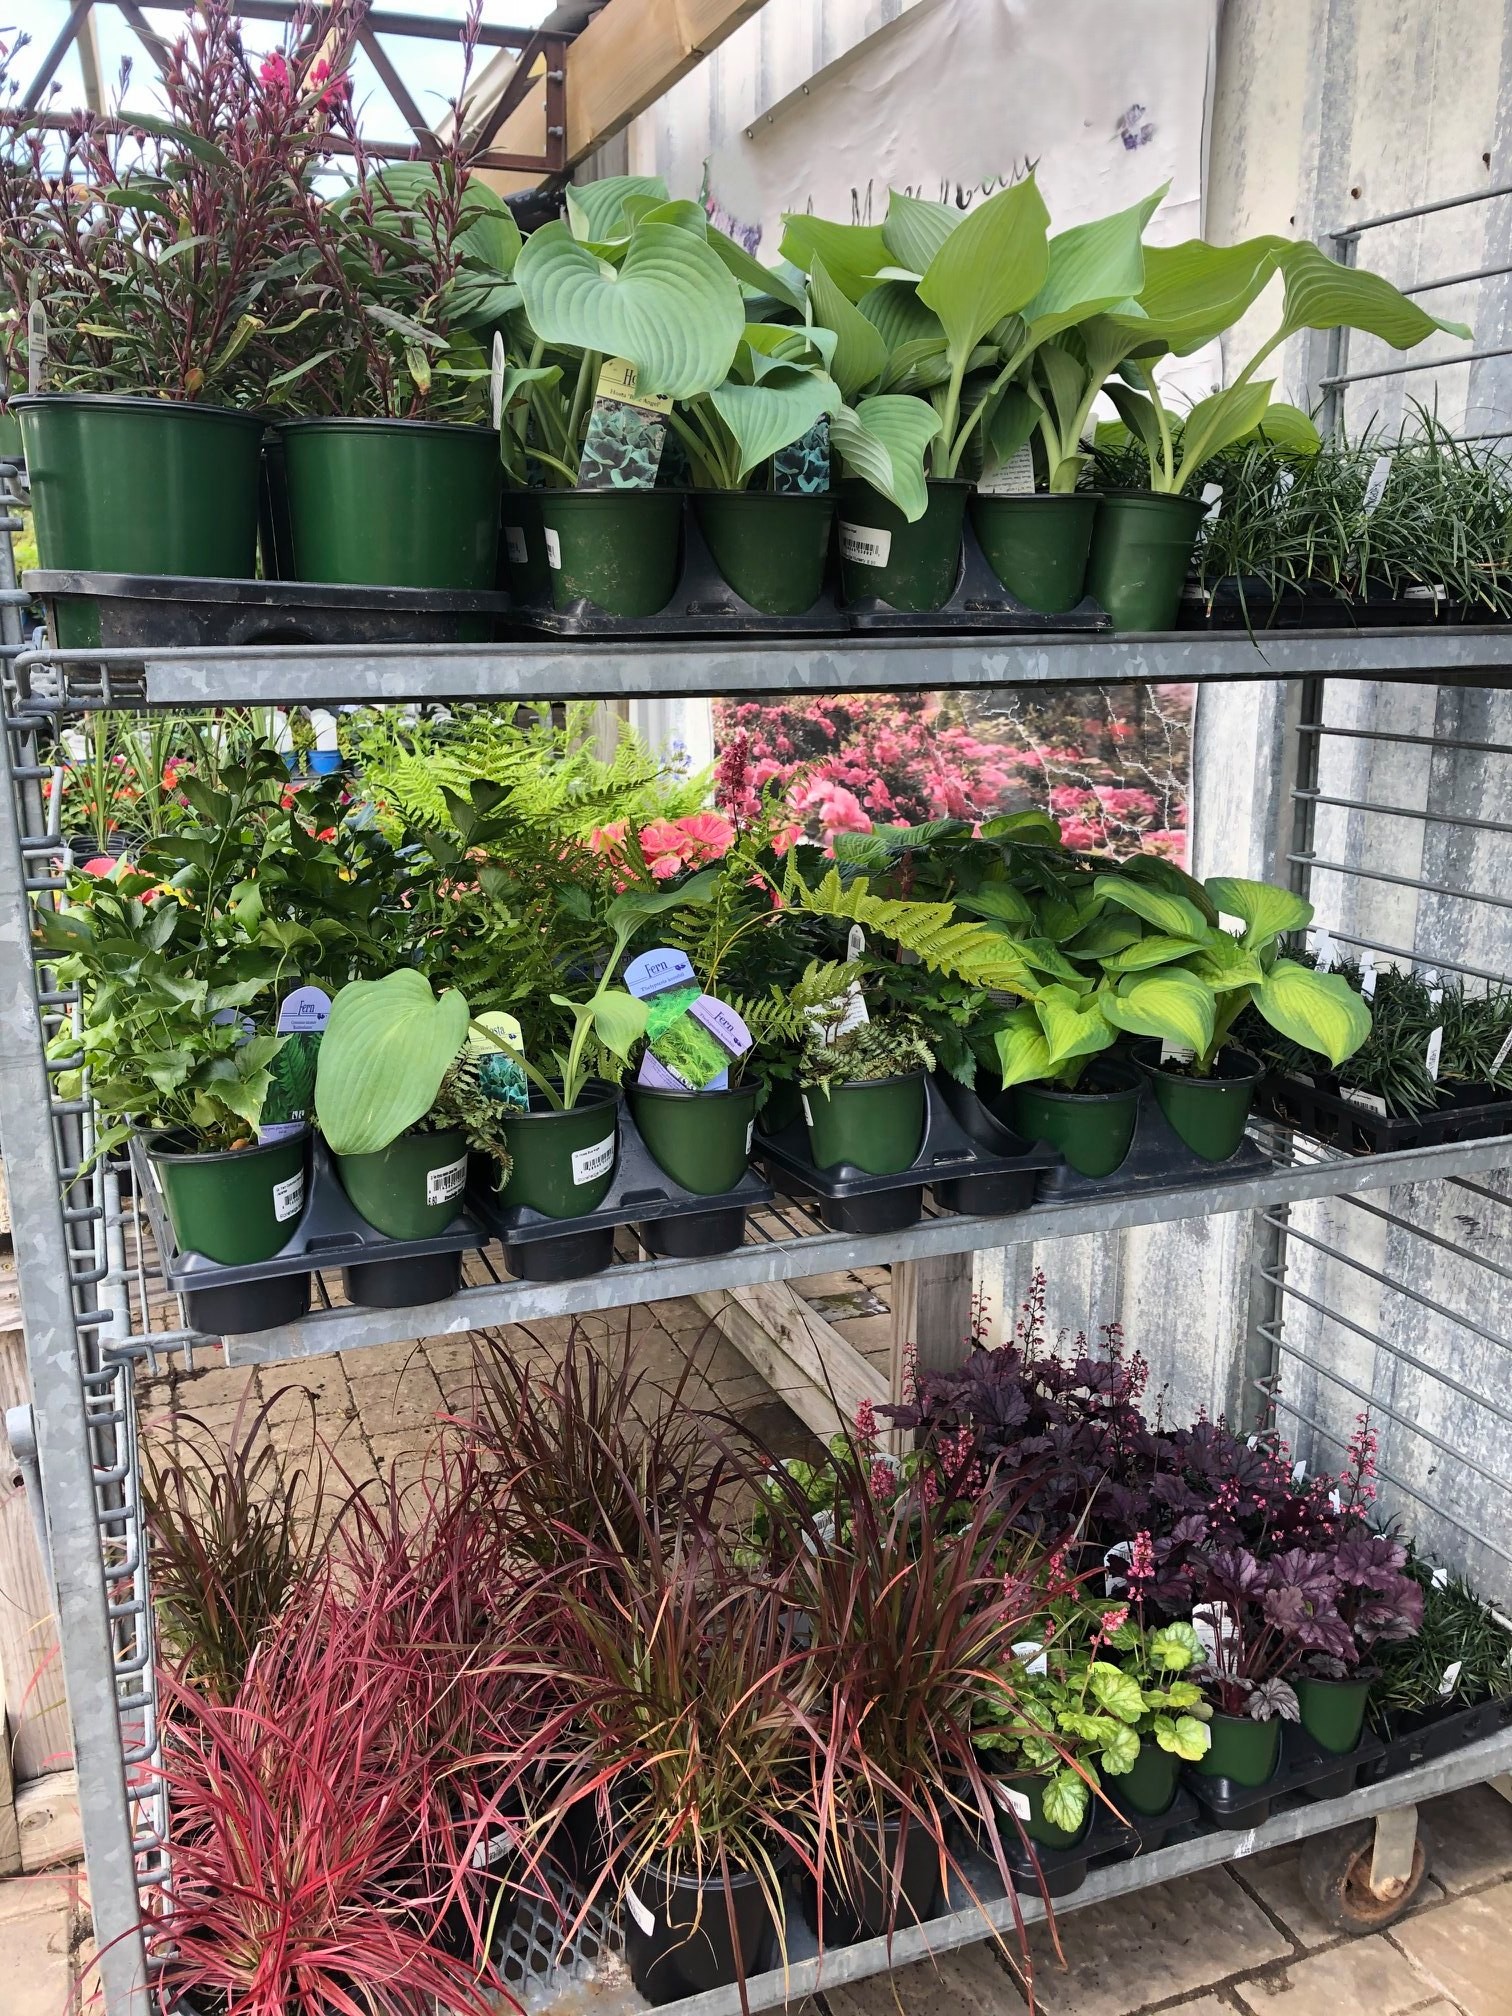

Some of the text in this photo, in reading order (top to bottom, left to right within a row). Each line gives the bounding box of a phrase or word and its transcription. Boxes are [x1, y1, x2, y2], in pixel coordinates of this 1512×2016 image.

[644, 961, 668, 978] Fern
[298, 1000, 315, 1016] Fern
[714, 1011, 734, 1031] Fern
